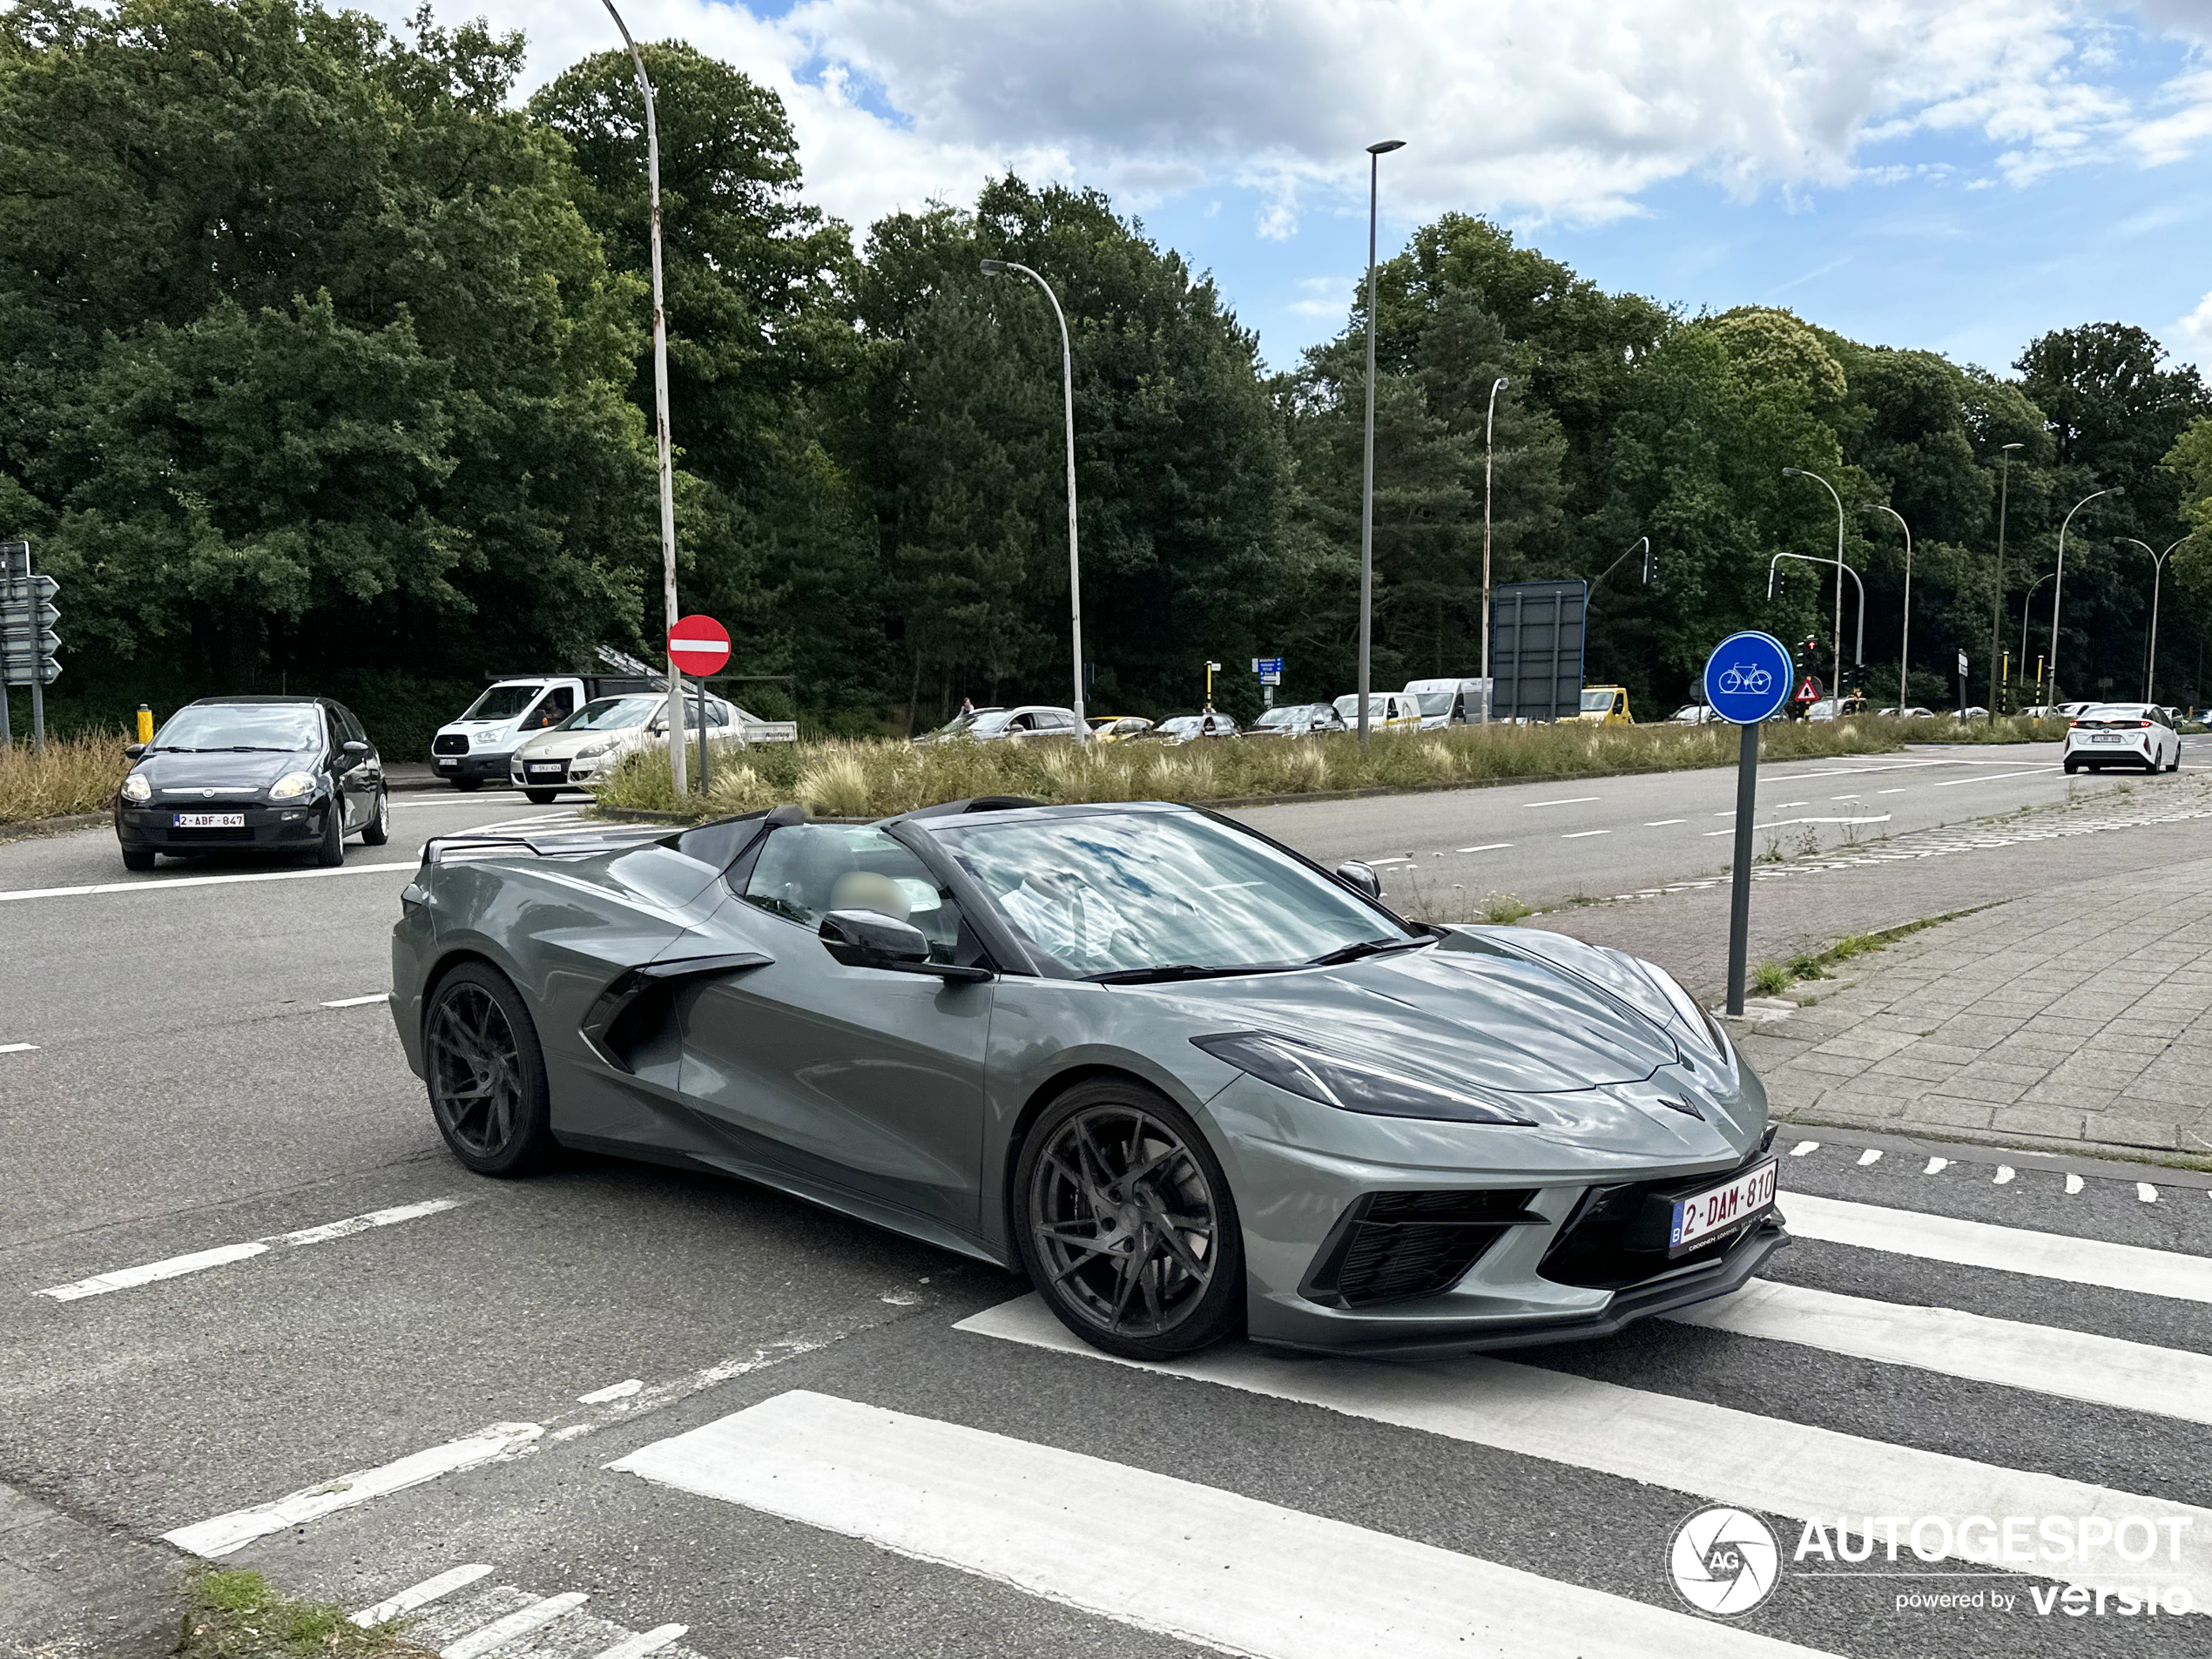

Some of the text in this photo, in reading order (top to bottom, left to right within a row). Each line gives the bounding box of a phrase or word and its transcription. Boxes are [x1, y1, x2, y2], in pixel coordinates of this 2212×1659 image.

[180, 815, 243, 826] 2-ABF-847
[1683, 1170, 1774, 1237] 2-DAM-810
[1672, 1228, 1681, 1244] B
[1689, 1236, 1716, 1252] CROONEN
